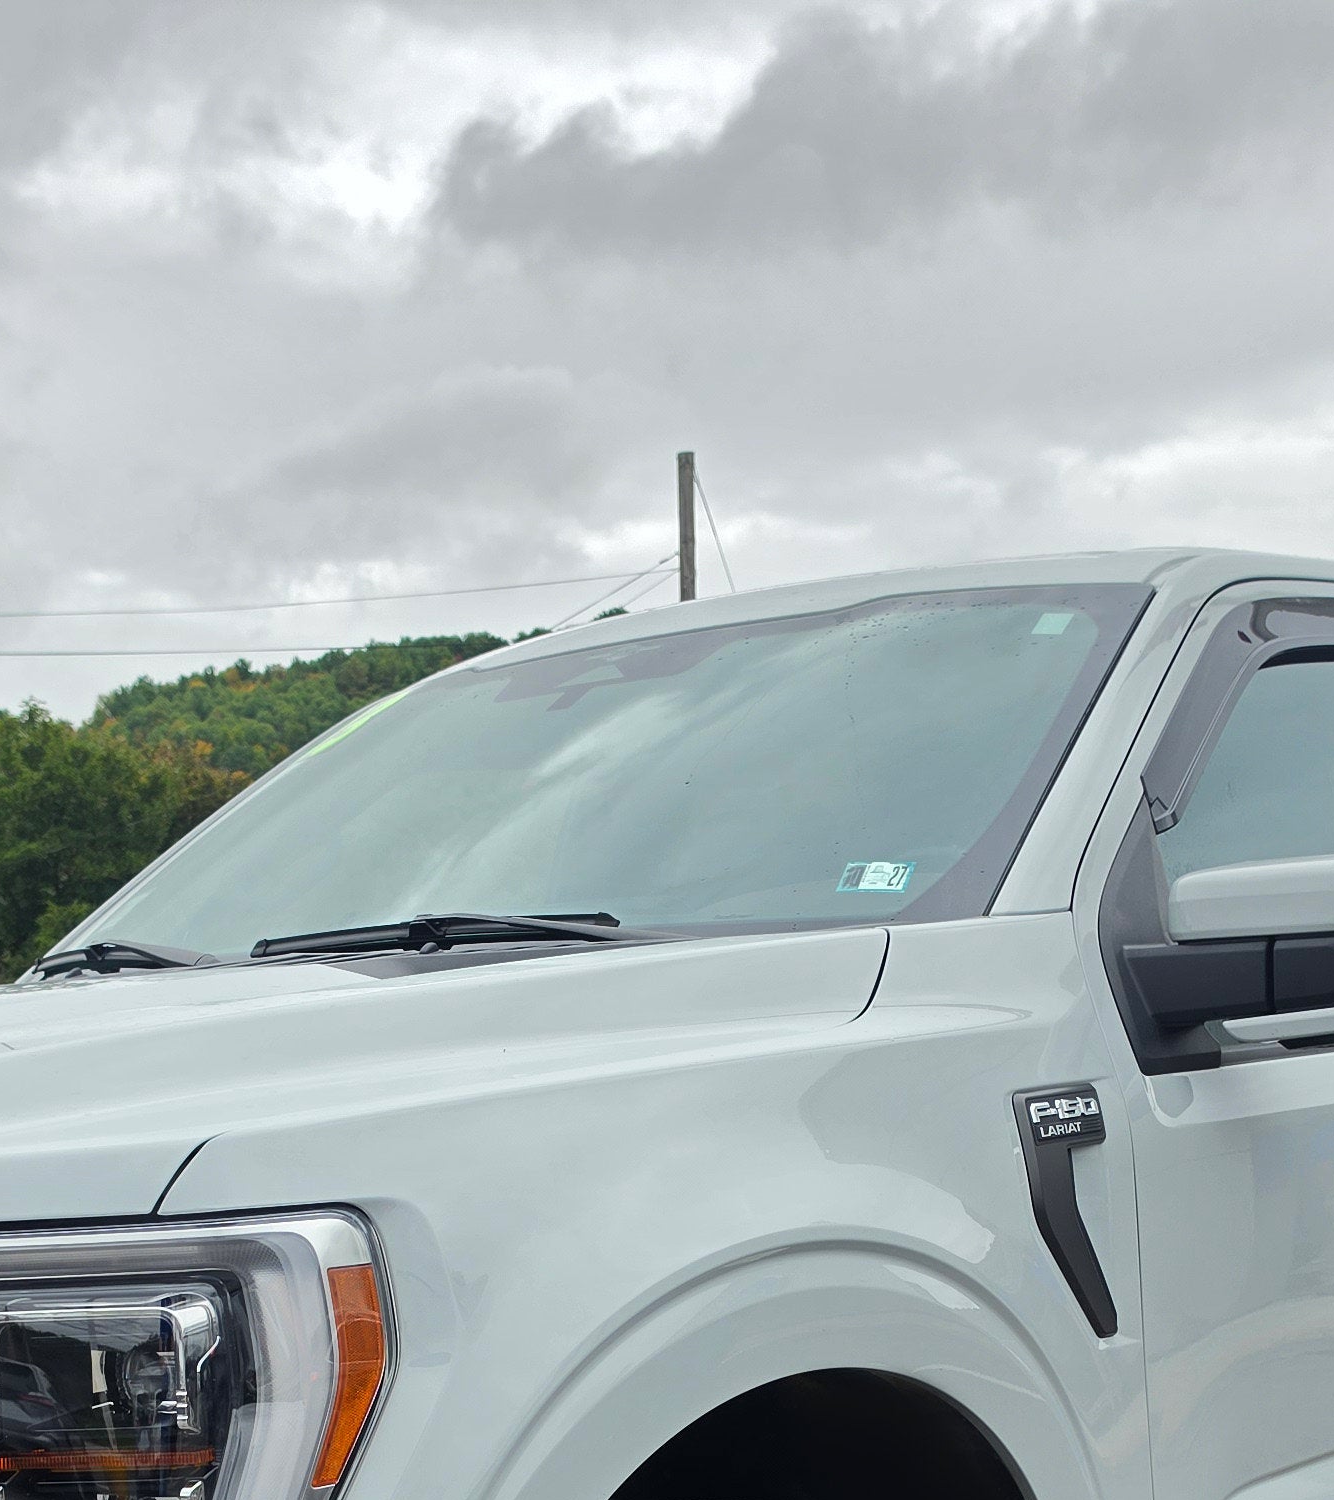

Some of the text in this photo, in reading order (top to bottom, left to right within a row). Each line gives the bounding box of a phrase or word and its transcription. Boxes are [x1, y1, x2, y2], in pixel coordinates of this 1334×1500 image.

[887, 865, 908, 888] 27
[1029, 1097, 1099, 1123] F-150
[1040, 1122, 1082, 1138] LARIAT
